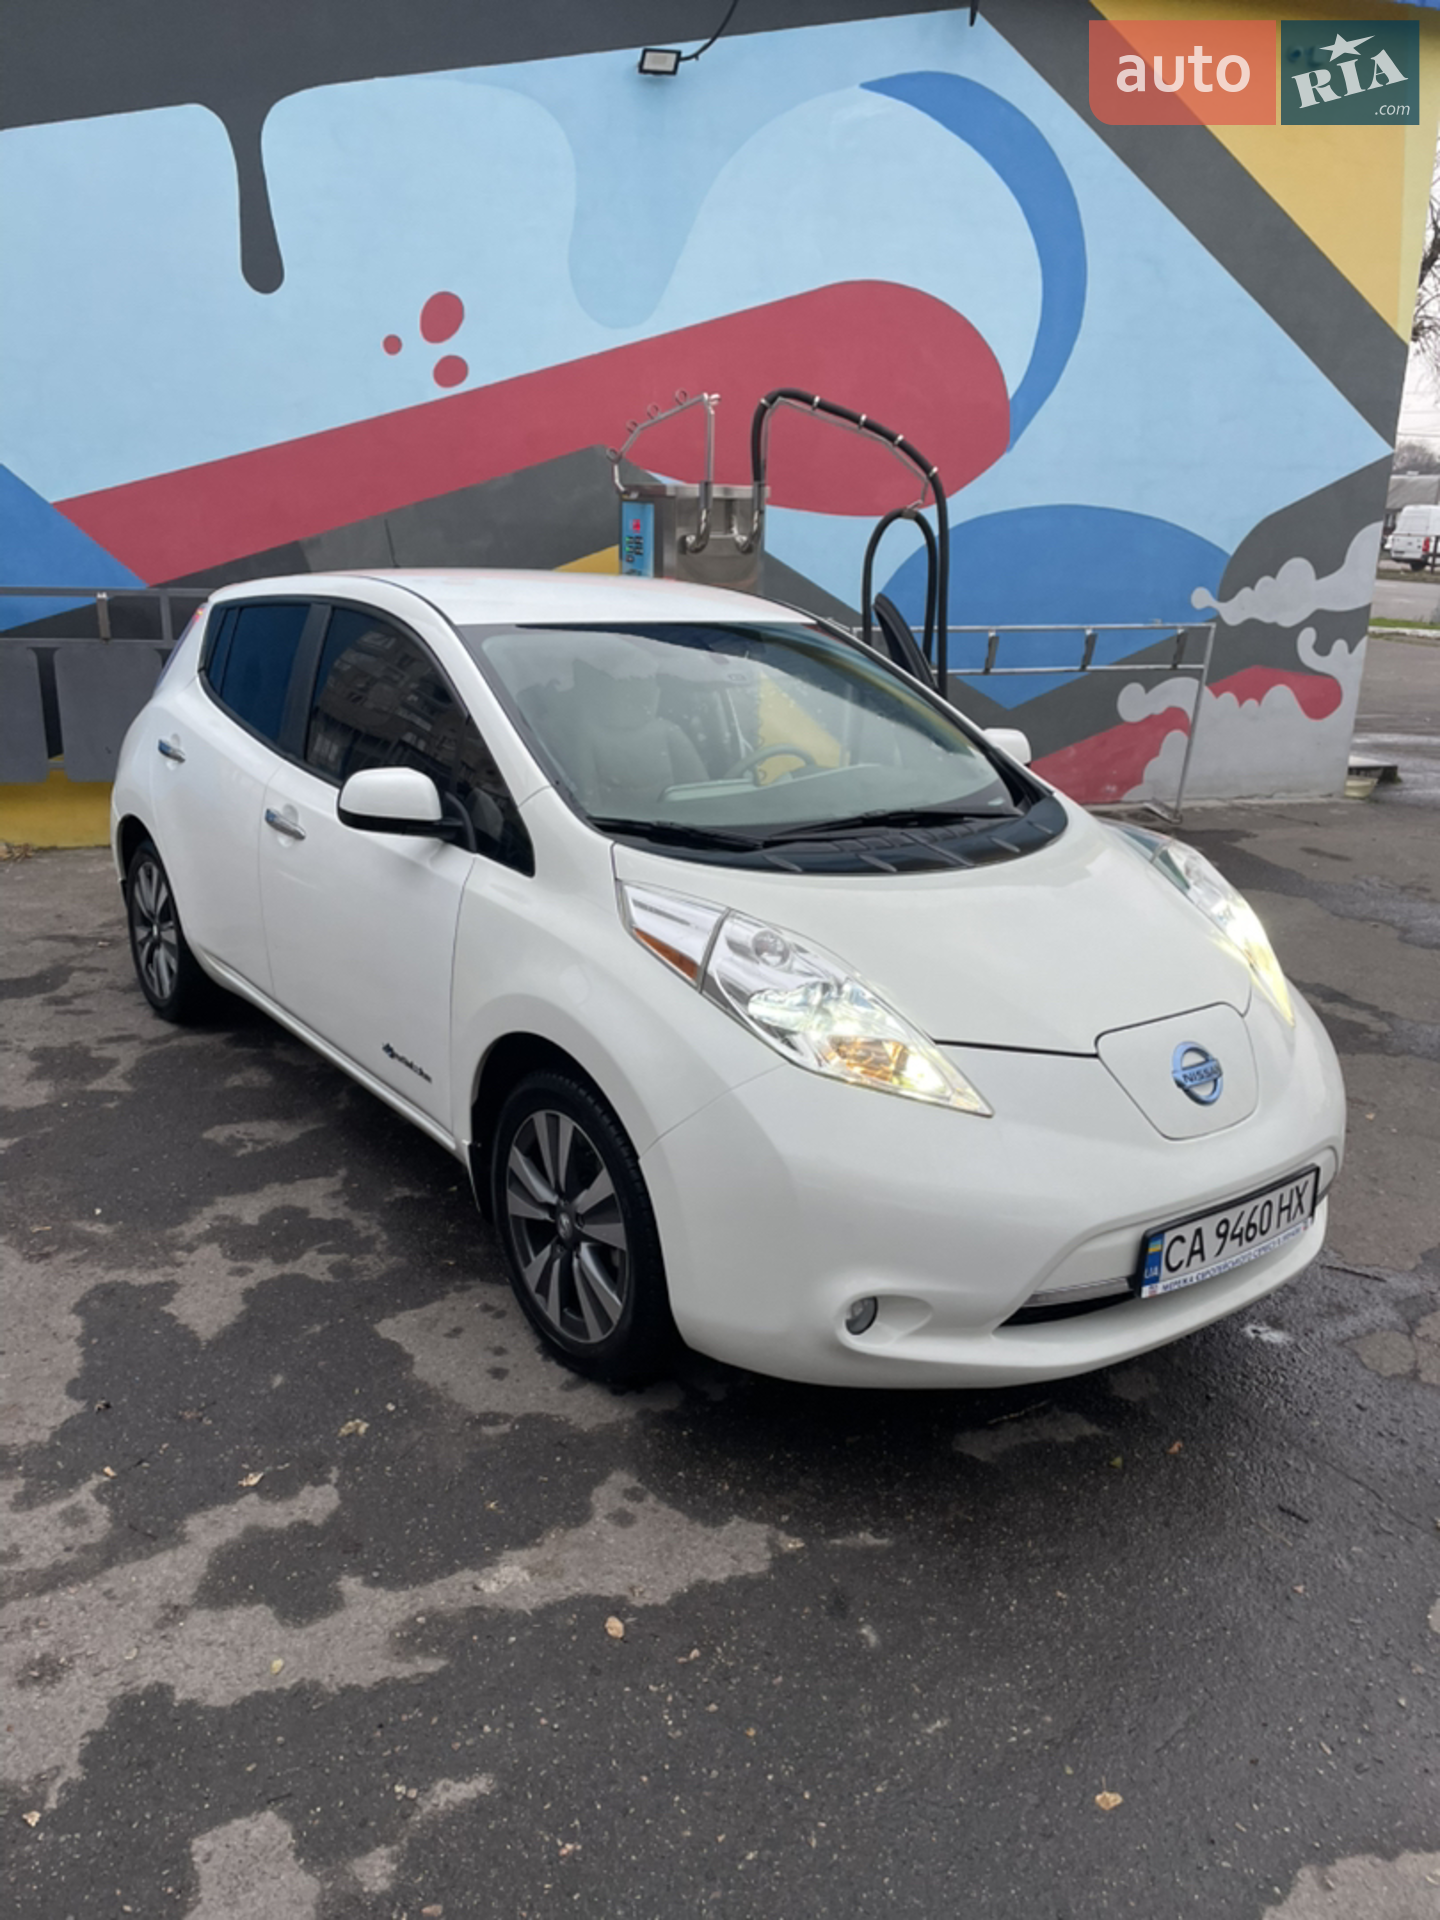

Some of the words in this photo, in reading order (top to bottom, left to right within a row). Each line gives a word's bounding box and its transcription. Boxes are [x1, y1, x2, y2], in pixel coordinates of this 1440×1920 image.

[1165, 1226, 1206, 1273] CA
[1214, 1199, 1273, 1257] 9460
[1276, 1180, 1309, 1228] HX
